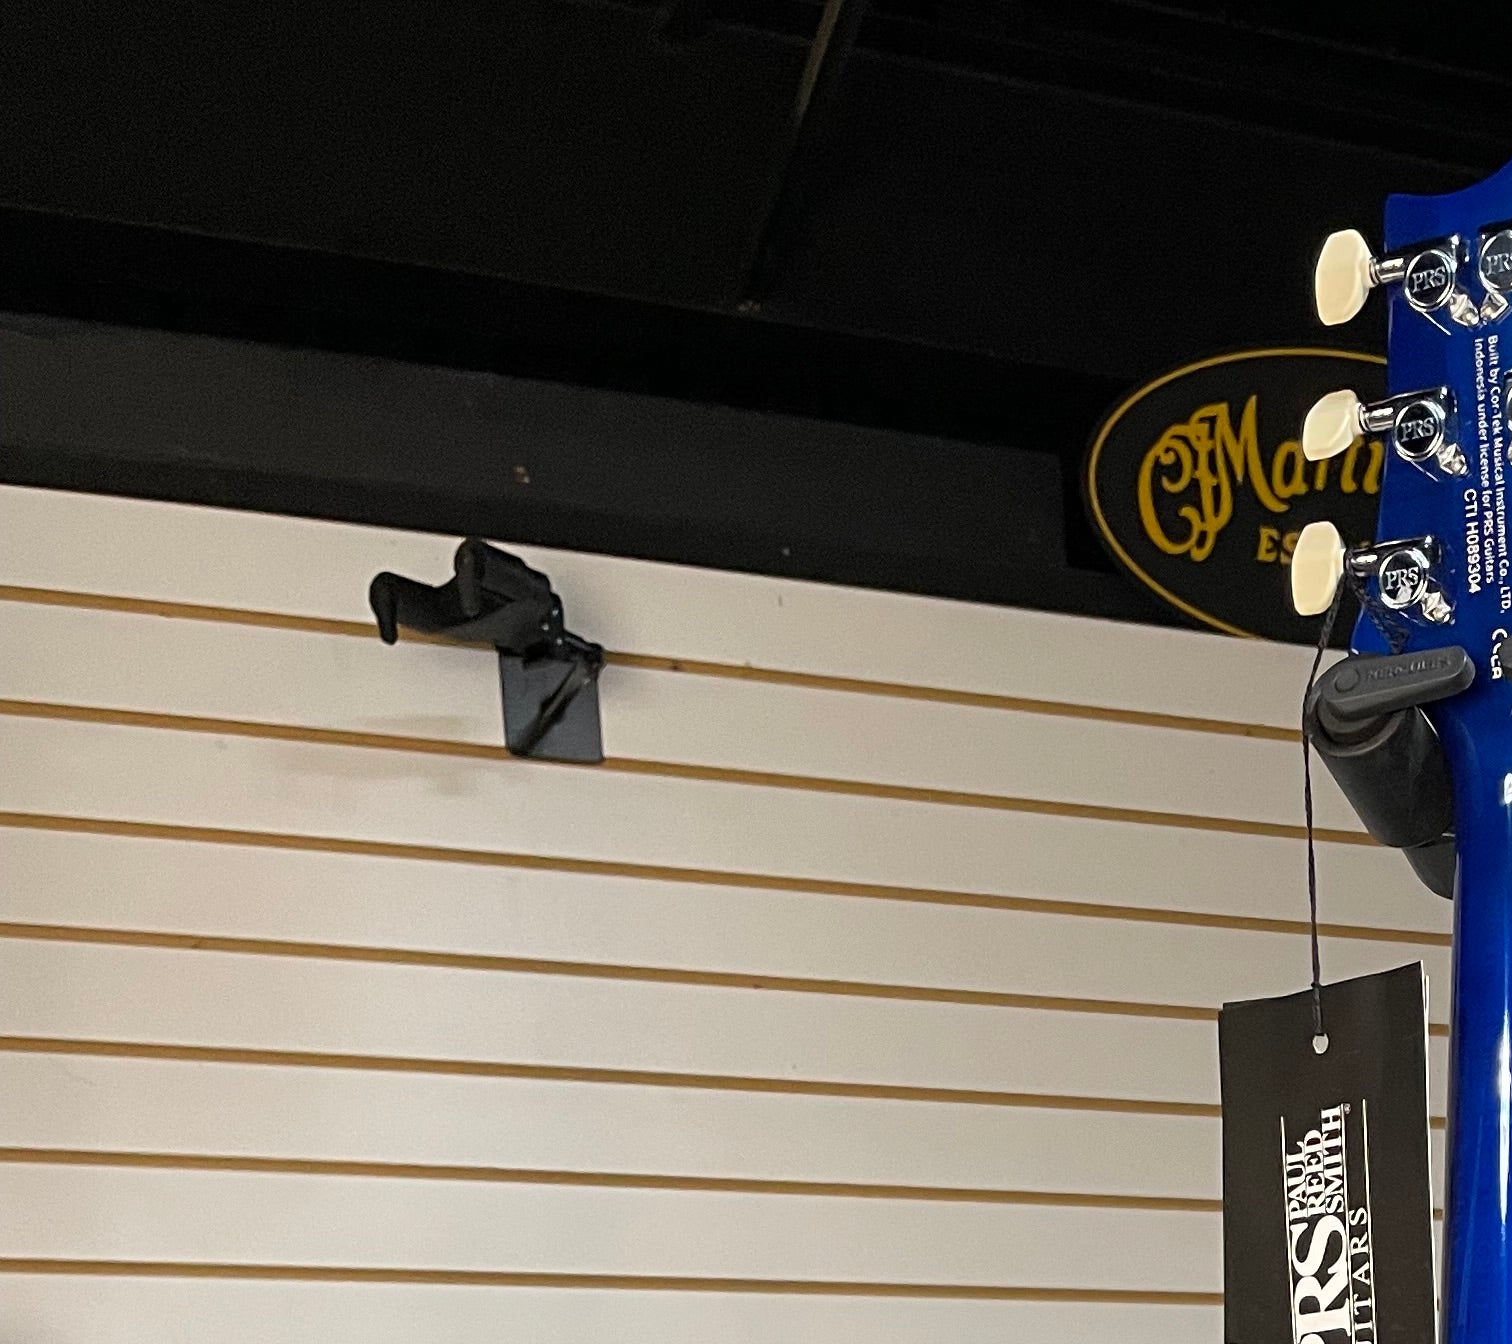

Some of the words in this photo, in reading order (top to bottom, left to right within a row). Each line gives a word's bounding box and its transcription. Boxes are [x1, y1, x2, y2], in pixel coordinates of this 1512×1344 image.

[1411, 266, 1446, 293] PRS
[1474, 338, 1487, 401] Indonesia
[1487, 335, 1499, 366] Built
[1488, 368, 1500, 385] by
[1400, 417, 1435, 442] PRS
[1476, 403, 1488, 441] under
[1490, 386, 1503, 435] Cor-Tek
[1478, 443, 1491, 488] license
[1492, 436, 1505, 485] Musical
[1463, 488, 1478, 518] CTI
[1481, 490, 1493, 509] for
[1482, 511, 1494, 536] PRS
[1495, 487, 1508, 558] Instrument
[1385, 566, 1419, 590] PRS
[1465, 522, 1481, 593] H089304
[1483, 538, 1496, 584] Guitars
[1286, 1141, 1308, 1219] PAUL
[1304, 1129, 1326, 1217] REED
[1321, 1105, 1344, 1214] SMITH
